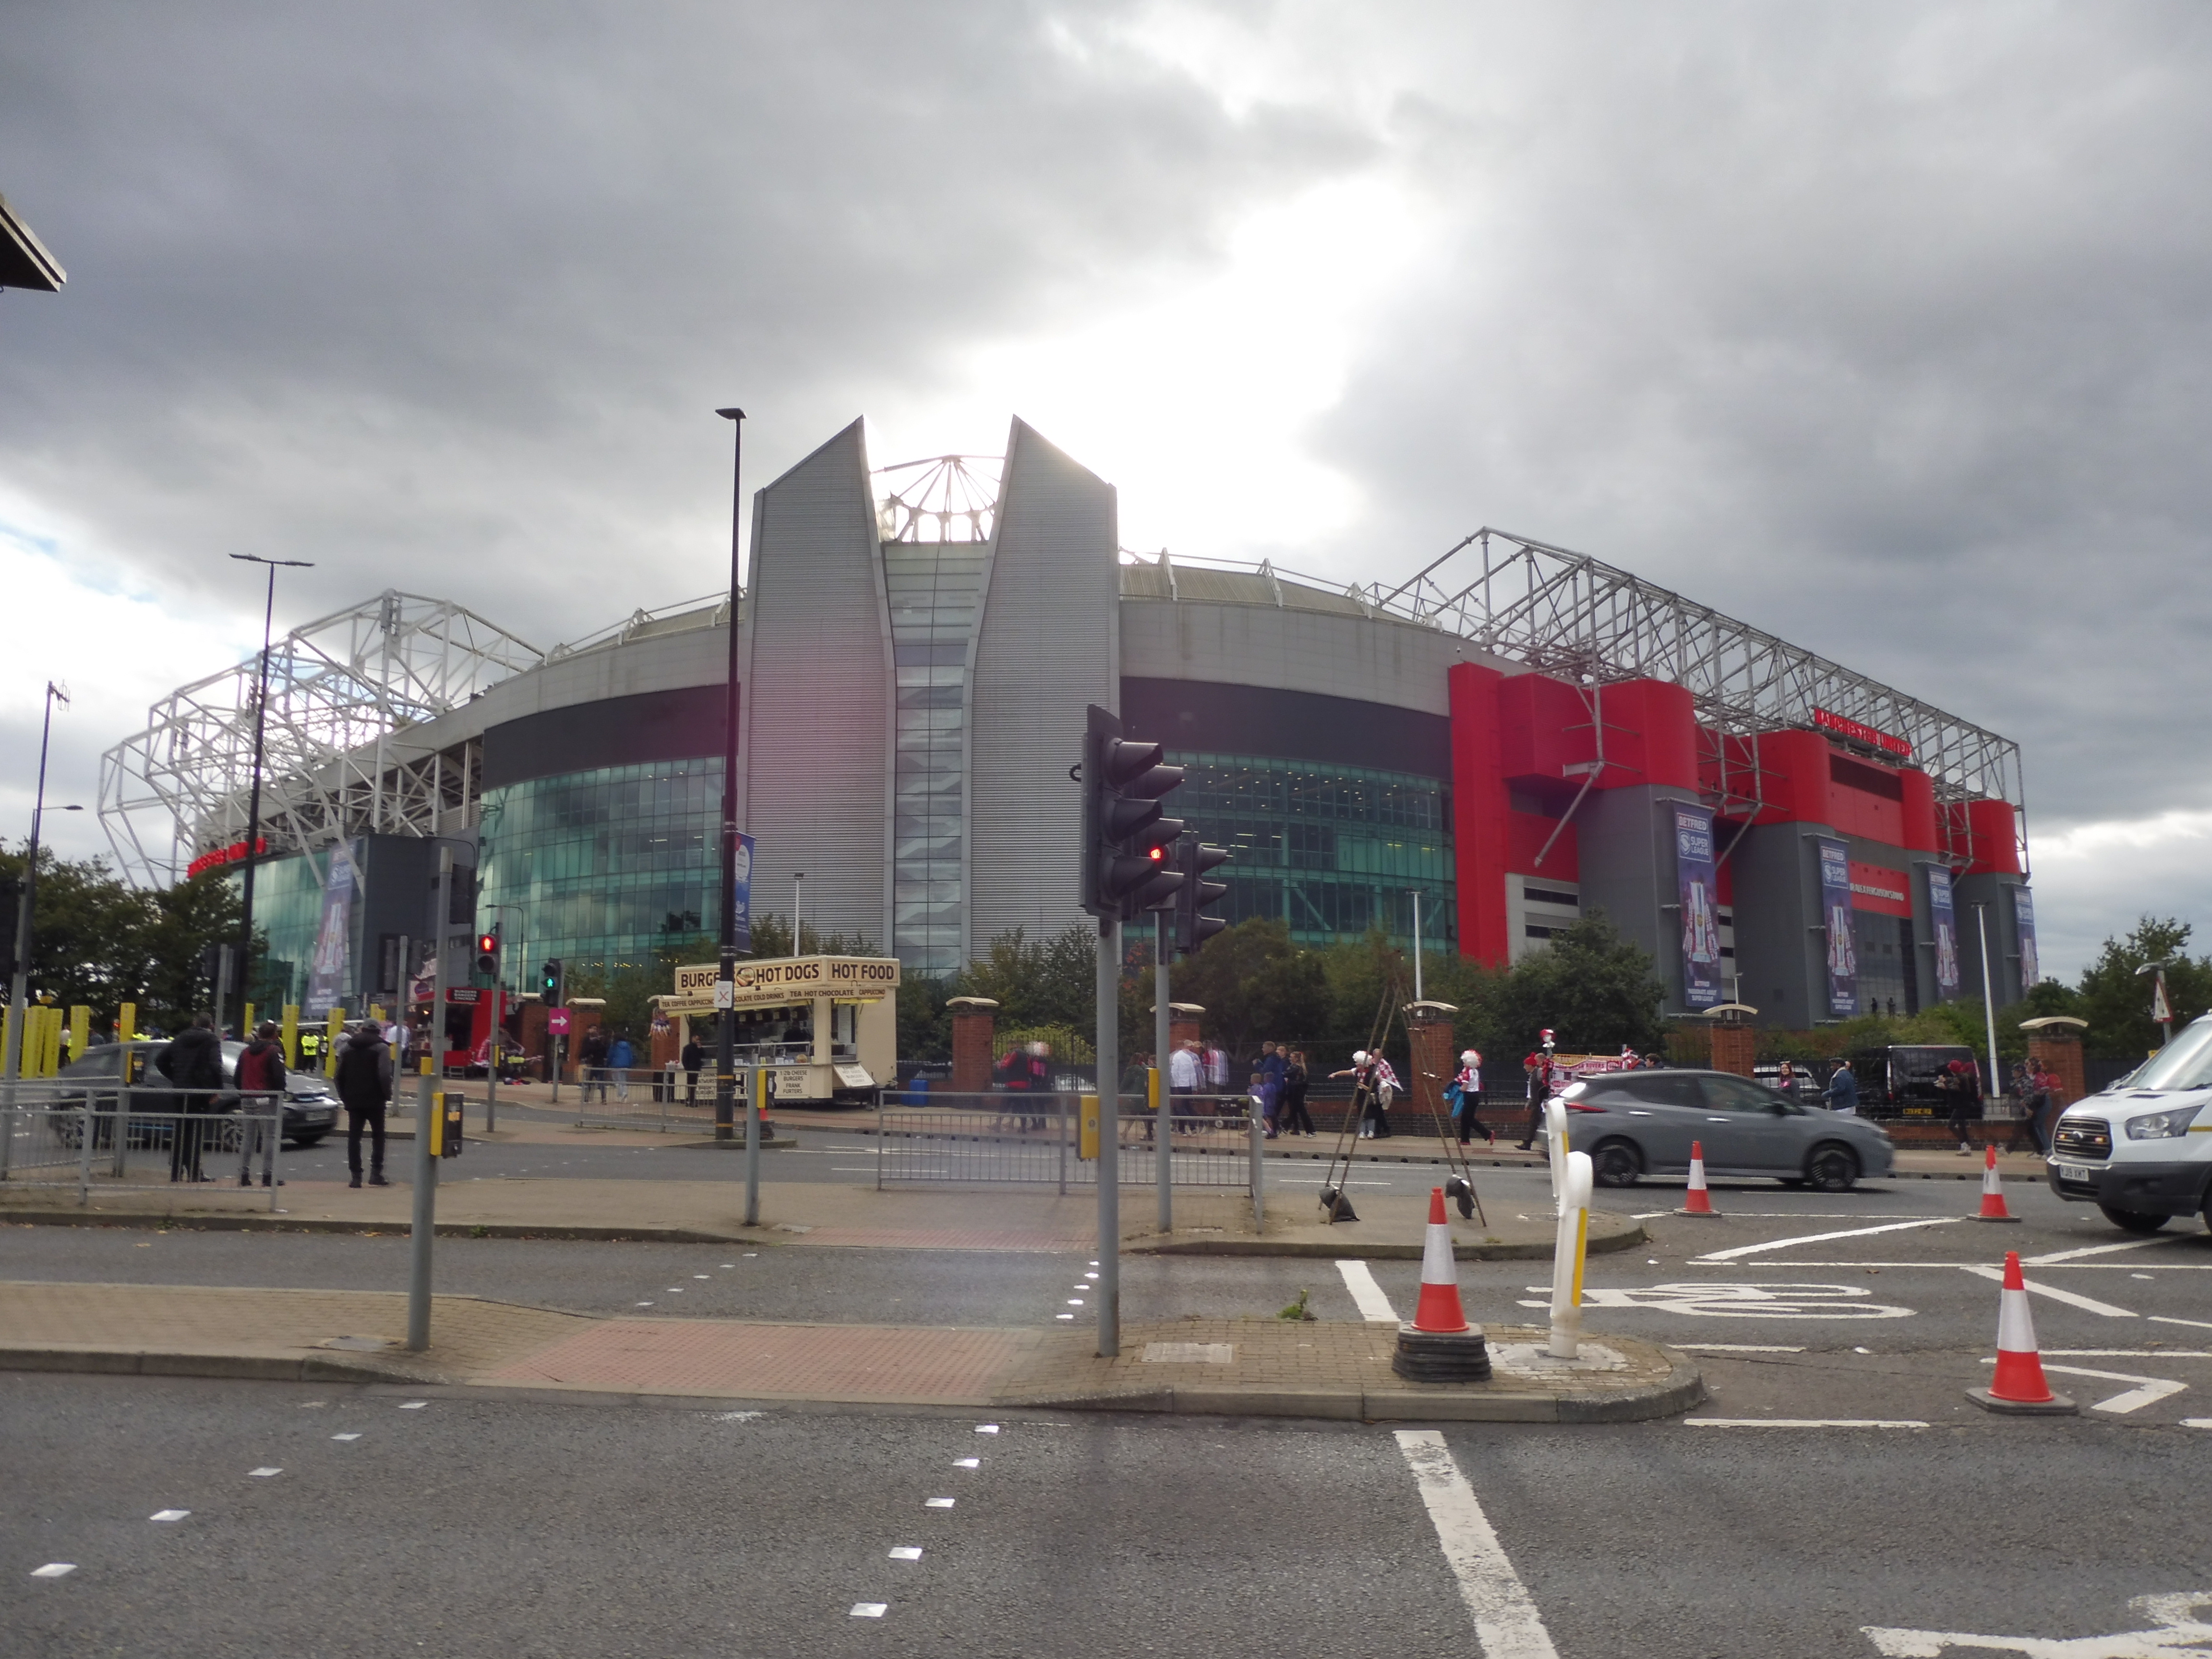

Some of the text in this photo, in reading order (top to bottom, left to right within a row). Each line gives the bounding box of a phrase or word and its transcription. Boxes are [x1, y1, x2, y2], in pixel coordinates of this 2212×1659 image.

[1679, 816, 1707, 830] BETFRED
[1690, 836, 1708, 848] SUPER
[1691, 846, 1709, 855] LEAGUE
[1822, 849, 1844, 861] BETFRED
[756, 967, 781, 984] HOT
[785, 963, 819, 981] DOGS
[832, 963, 894, 980] HOT FOOD
